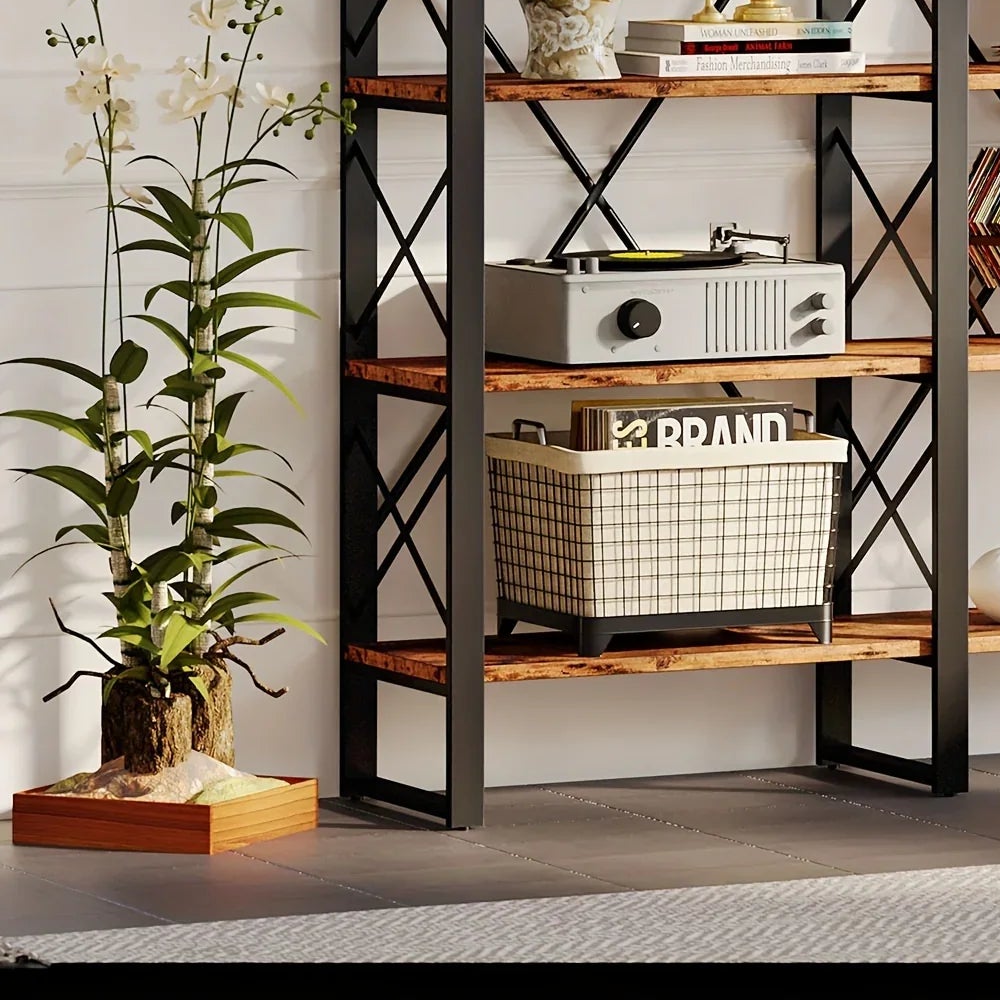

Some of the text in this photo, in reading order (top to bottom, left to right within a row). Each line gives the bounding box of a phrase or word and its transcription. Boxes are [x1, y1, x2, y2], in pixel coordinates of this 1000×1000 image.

[700, 27, 733, 39] WOMAN
[745, 42, 773, 51] ANIMAL
[775, 40, 793, 50] FARM
[696, 56, 728, 72] Fashion
[730, 55, 792, 72] Merchandising
